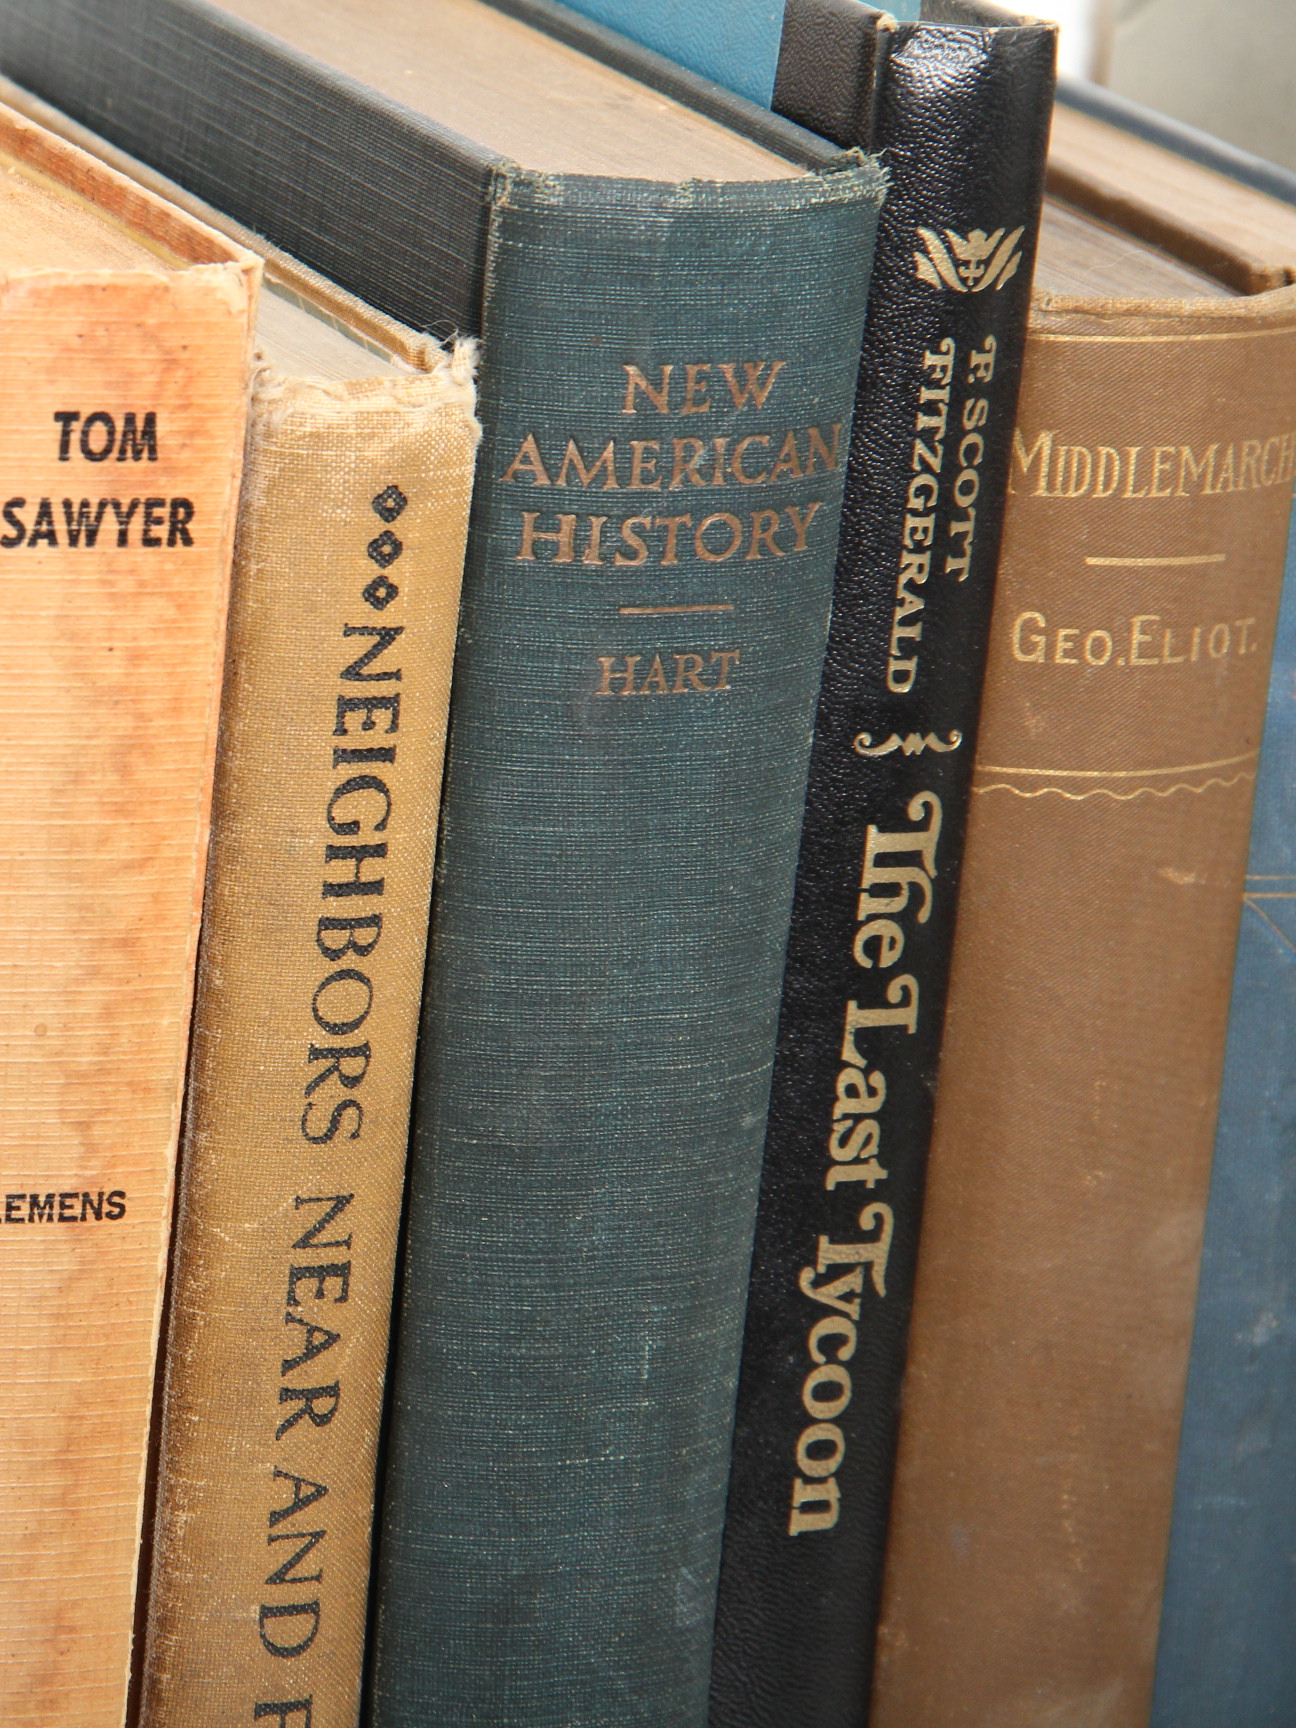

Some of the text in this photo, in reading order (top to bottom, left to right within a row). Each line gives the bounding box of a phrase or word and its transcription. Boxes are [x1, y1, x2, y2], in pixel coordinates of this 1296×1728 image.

[621, 361, 787, 416] NEW
[54, 411, 158, 462] TOM
[500, 422, 843, 492] AMERICAN
[1008, 428, 1296, 498] MIDDLEMARCH
[0, 497, 195, 548] SAWYER
[887, 337, 955, 694] FITZGERALD
[944, 397, 990, 582] SCOTT
[515, 502, 828, 567] HISTORY
[595, 650, 741, 697] HART
[299, 623, 404, 1145] NEIGHBORS
[787, 790, 943, 1537] The Last Tycoon
[275, 1193, 352, 1442] NEAR
[259, 1465, 330, 1659] AND
